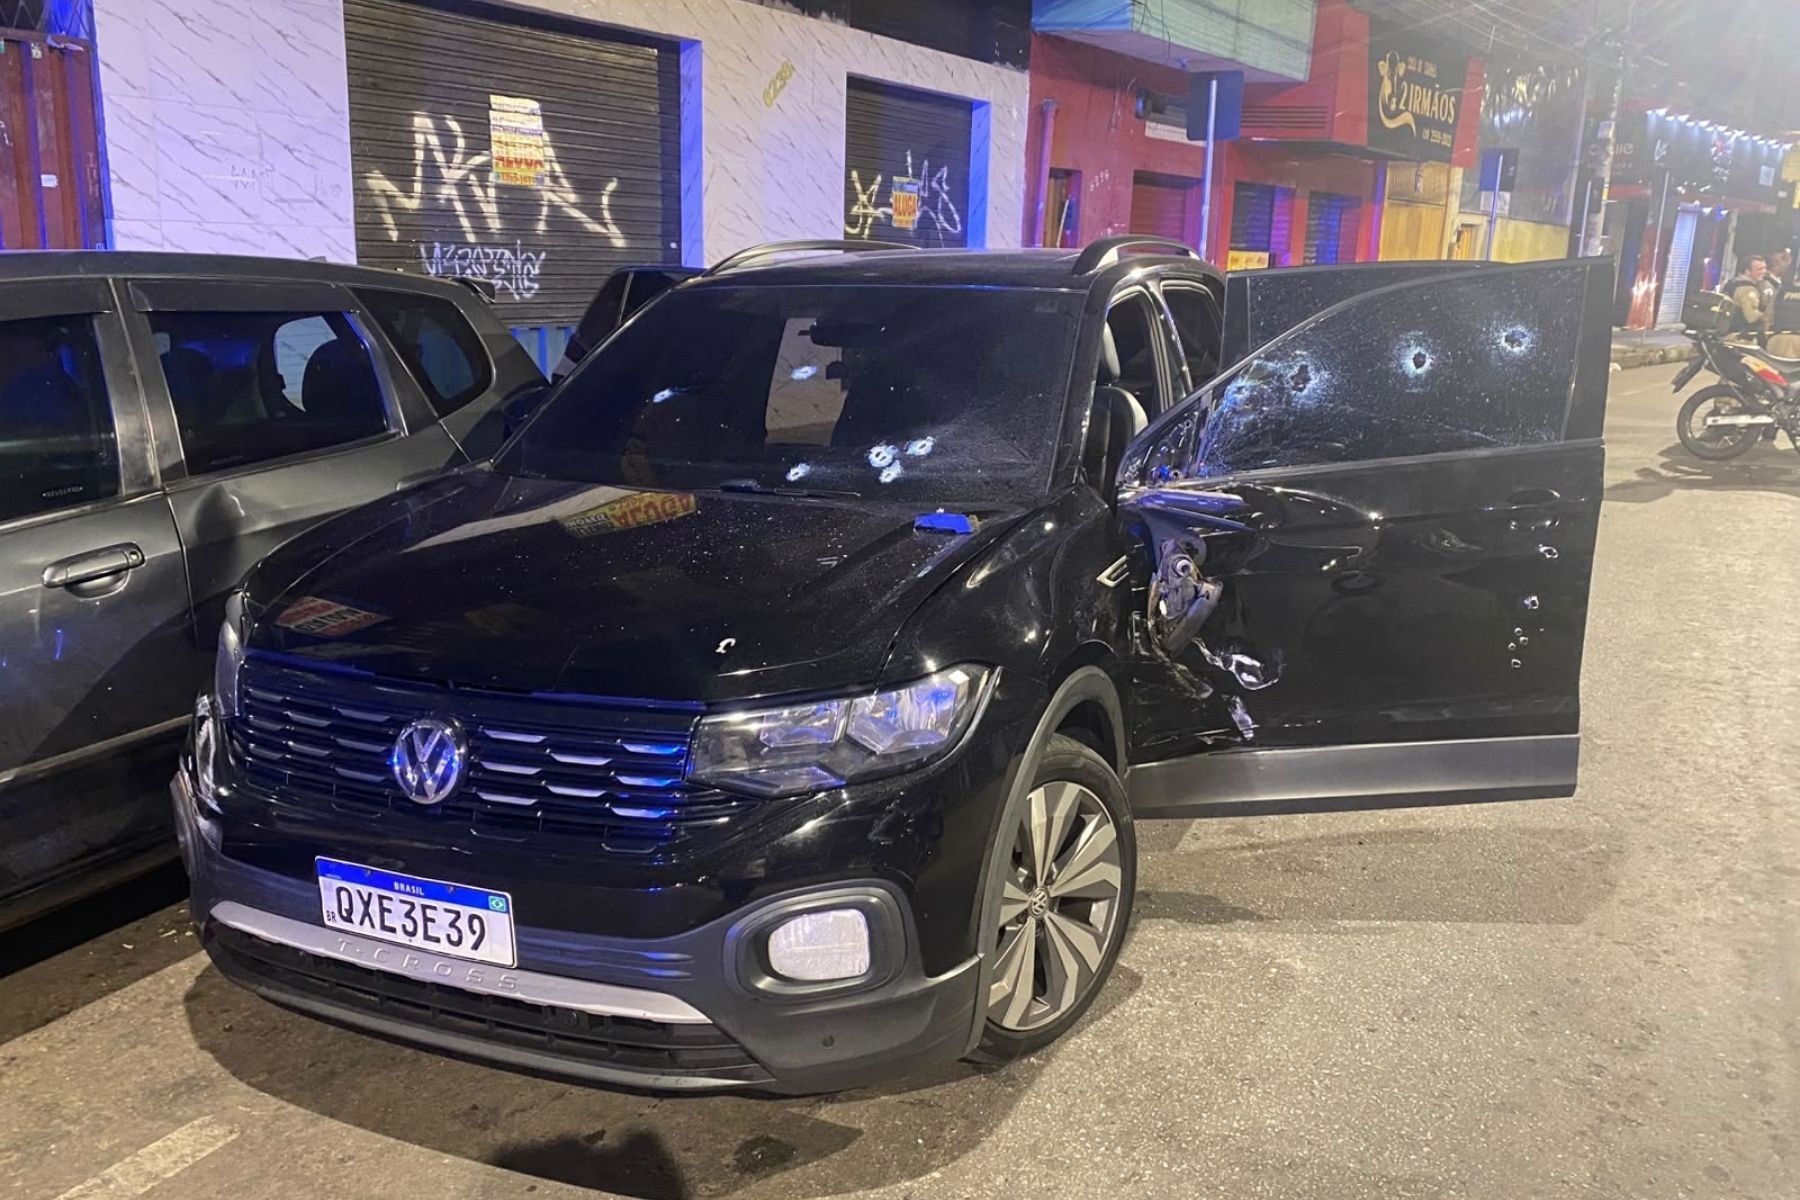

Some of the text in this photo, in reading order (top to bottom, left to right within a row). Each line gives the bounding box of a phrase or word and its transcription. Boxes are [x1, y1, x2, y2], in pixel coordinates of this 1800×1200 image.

[1399, 81, 1408, 111] 2
[393, 881, 425, 896] BRASIL
[326, 910, 336, 922] BR
[336, 886, 486, 951] QXE3E39
